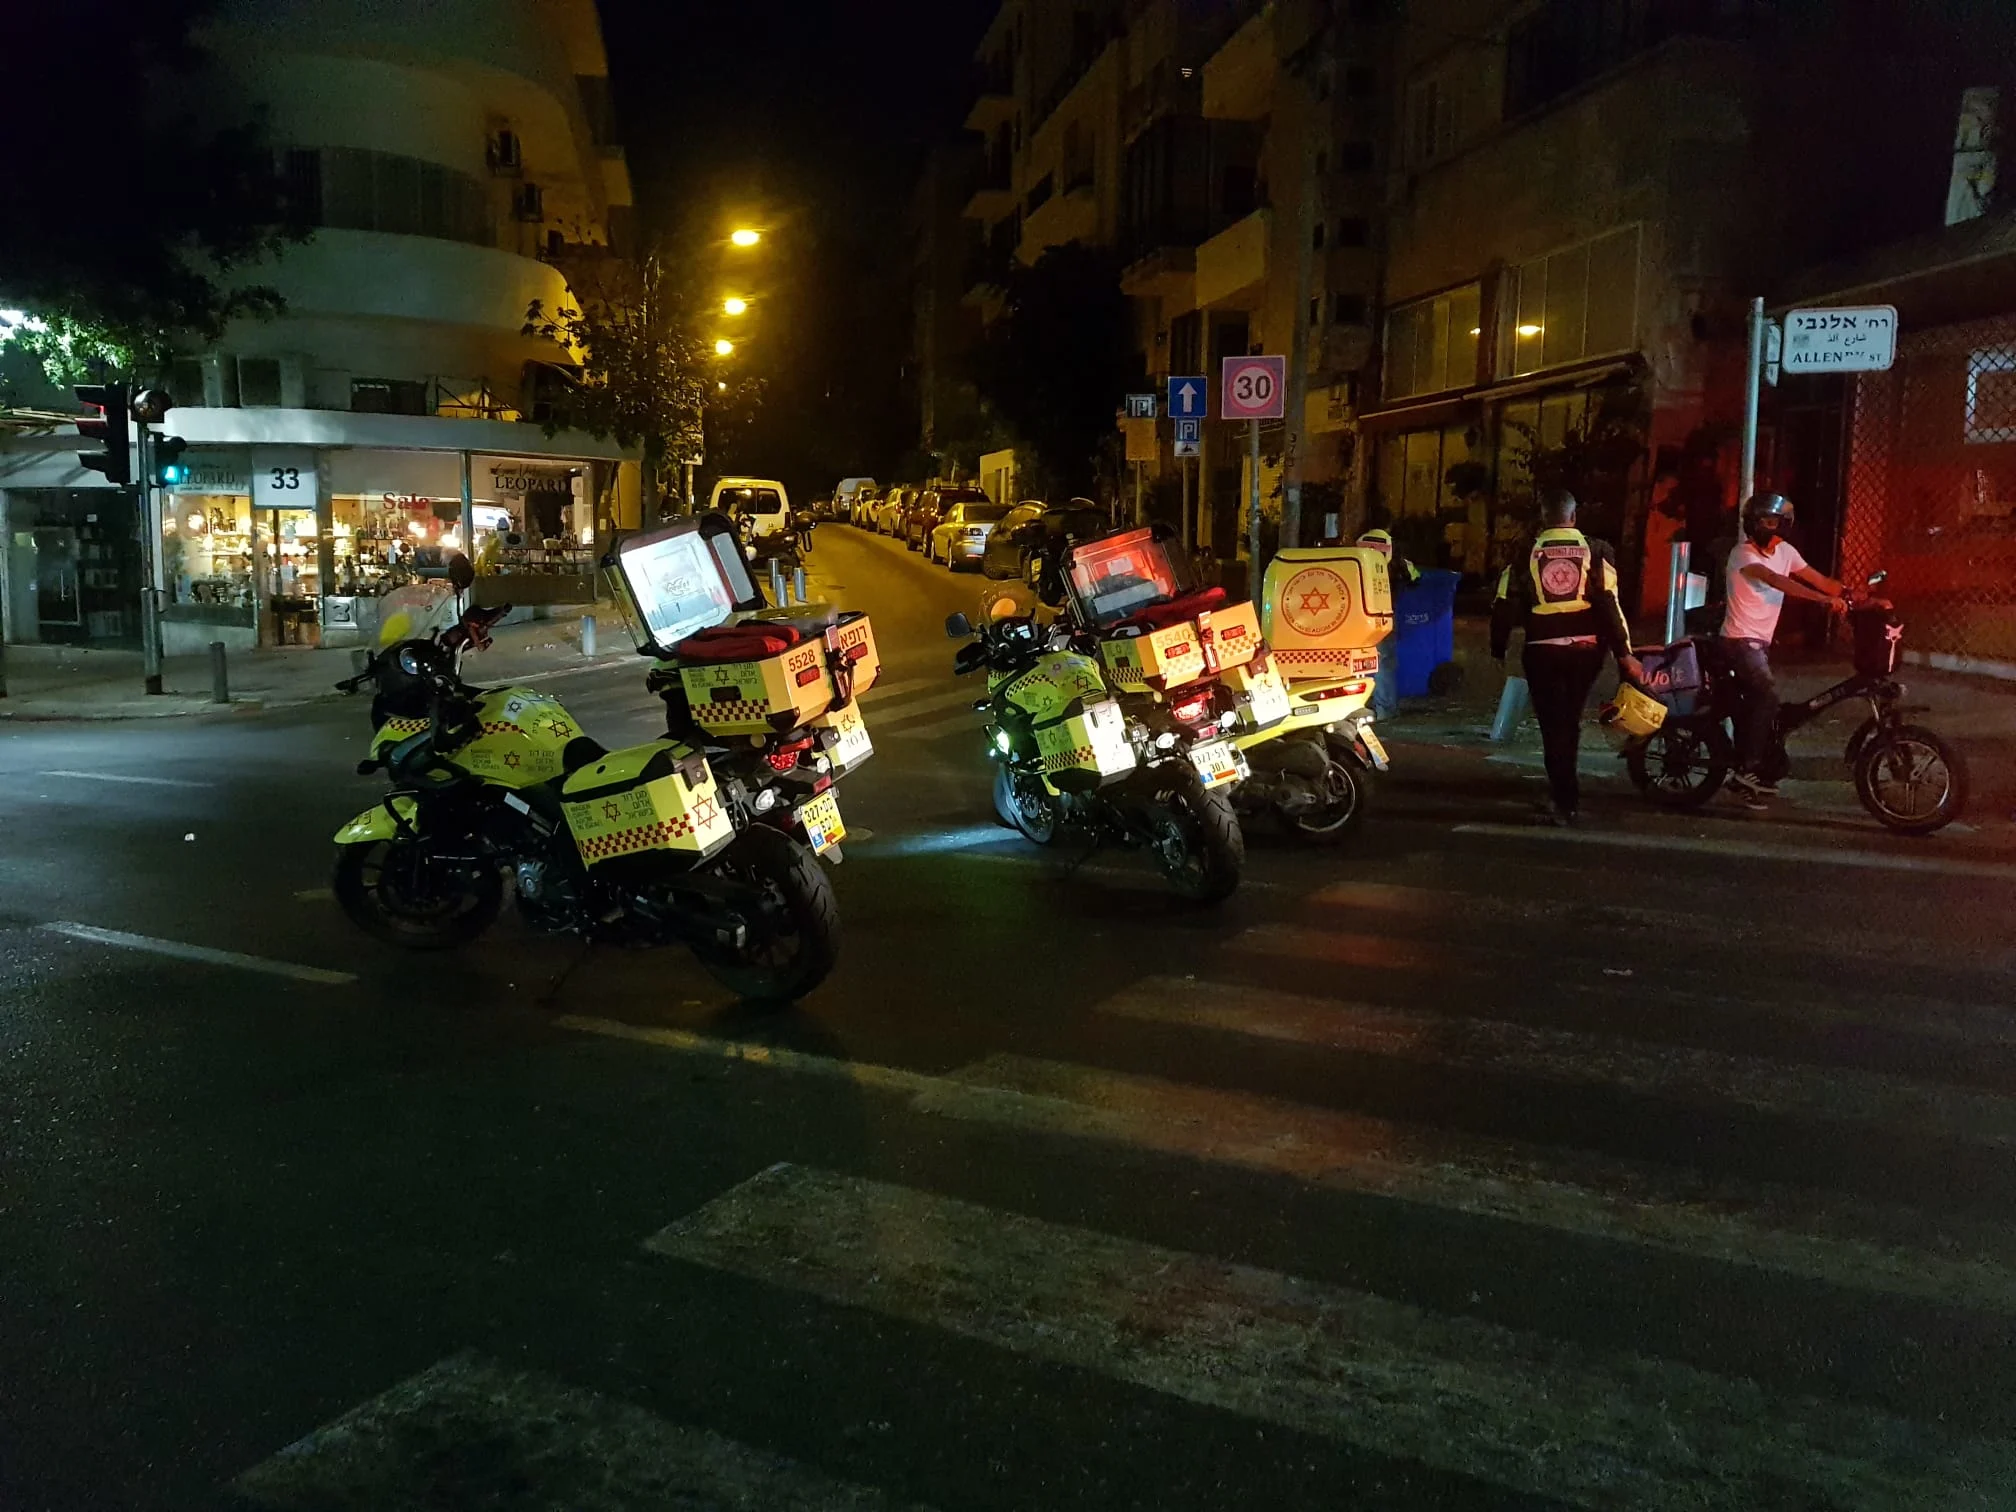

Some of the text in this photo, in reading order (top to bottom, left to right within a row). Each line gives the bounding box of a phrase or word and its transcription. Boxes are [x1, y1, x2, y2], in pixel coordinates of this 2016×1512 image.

[1797, 314, 1857, 330] אלנבי
[1792, 351, 1865, 364] ALLEN
[1237, 375, 1271, 400] 30
[271, 467, 299, 490] 33
[495, 476, 569, 493] LEOPARD
[383, 492, 430, 511] Sale
[840, 625, 868, 649] רופא
[788, 649, 816, 672] 5528
